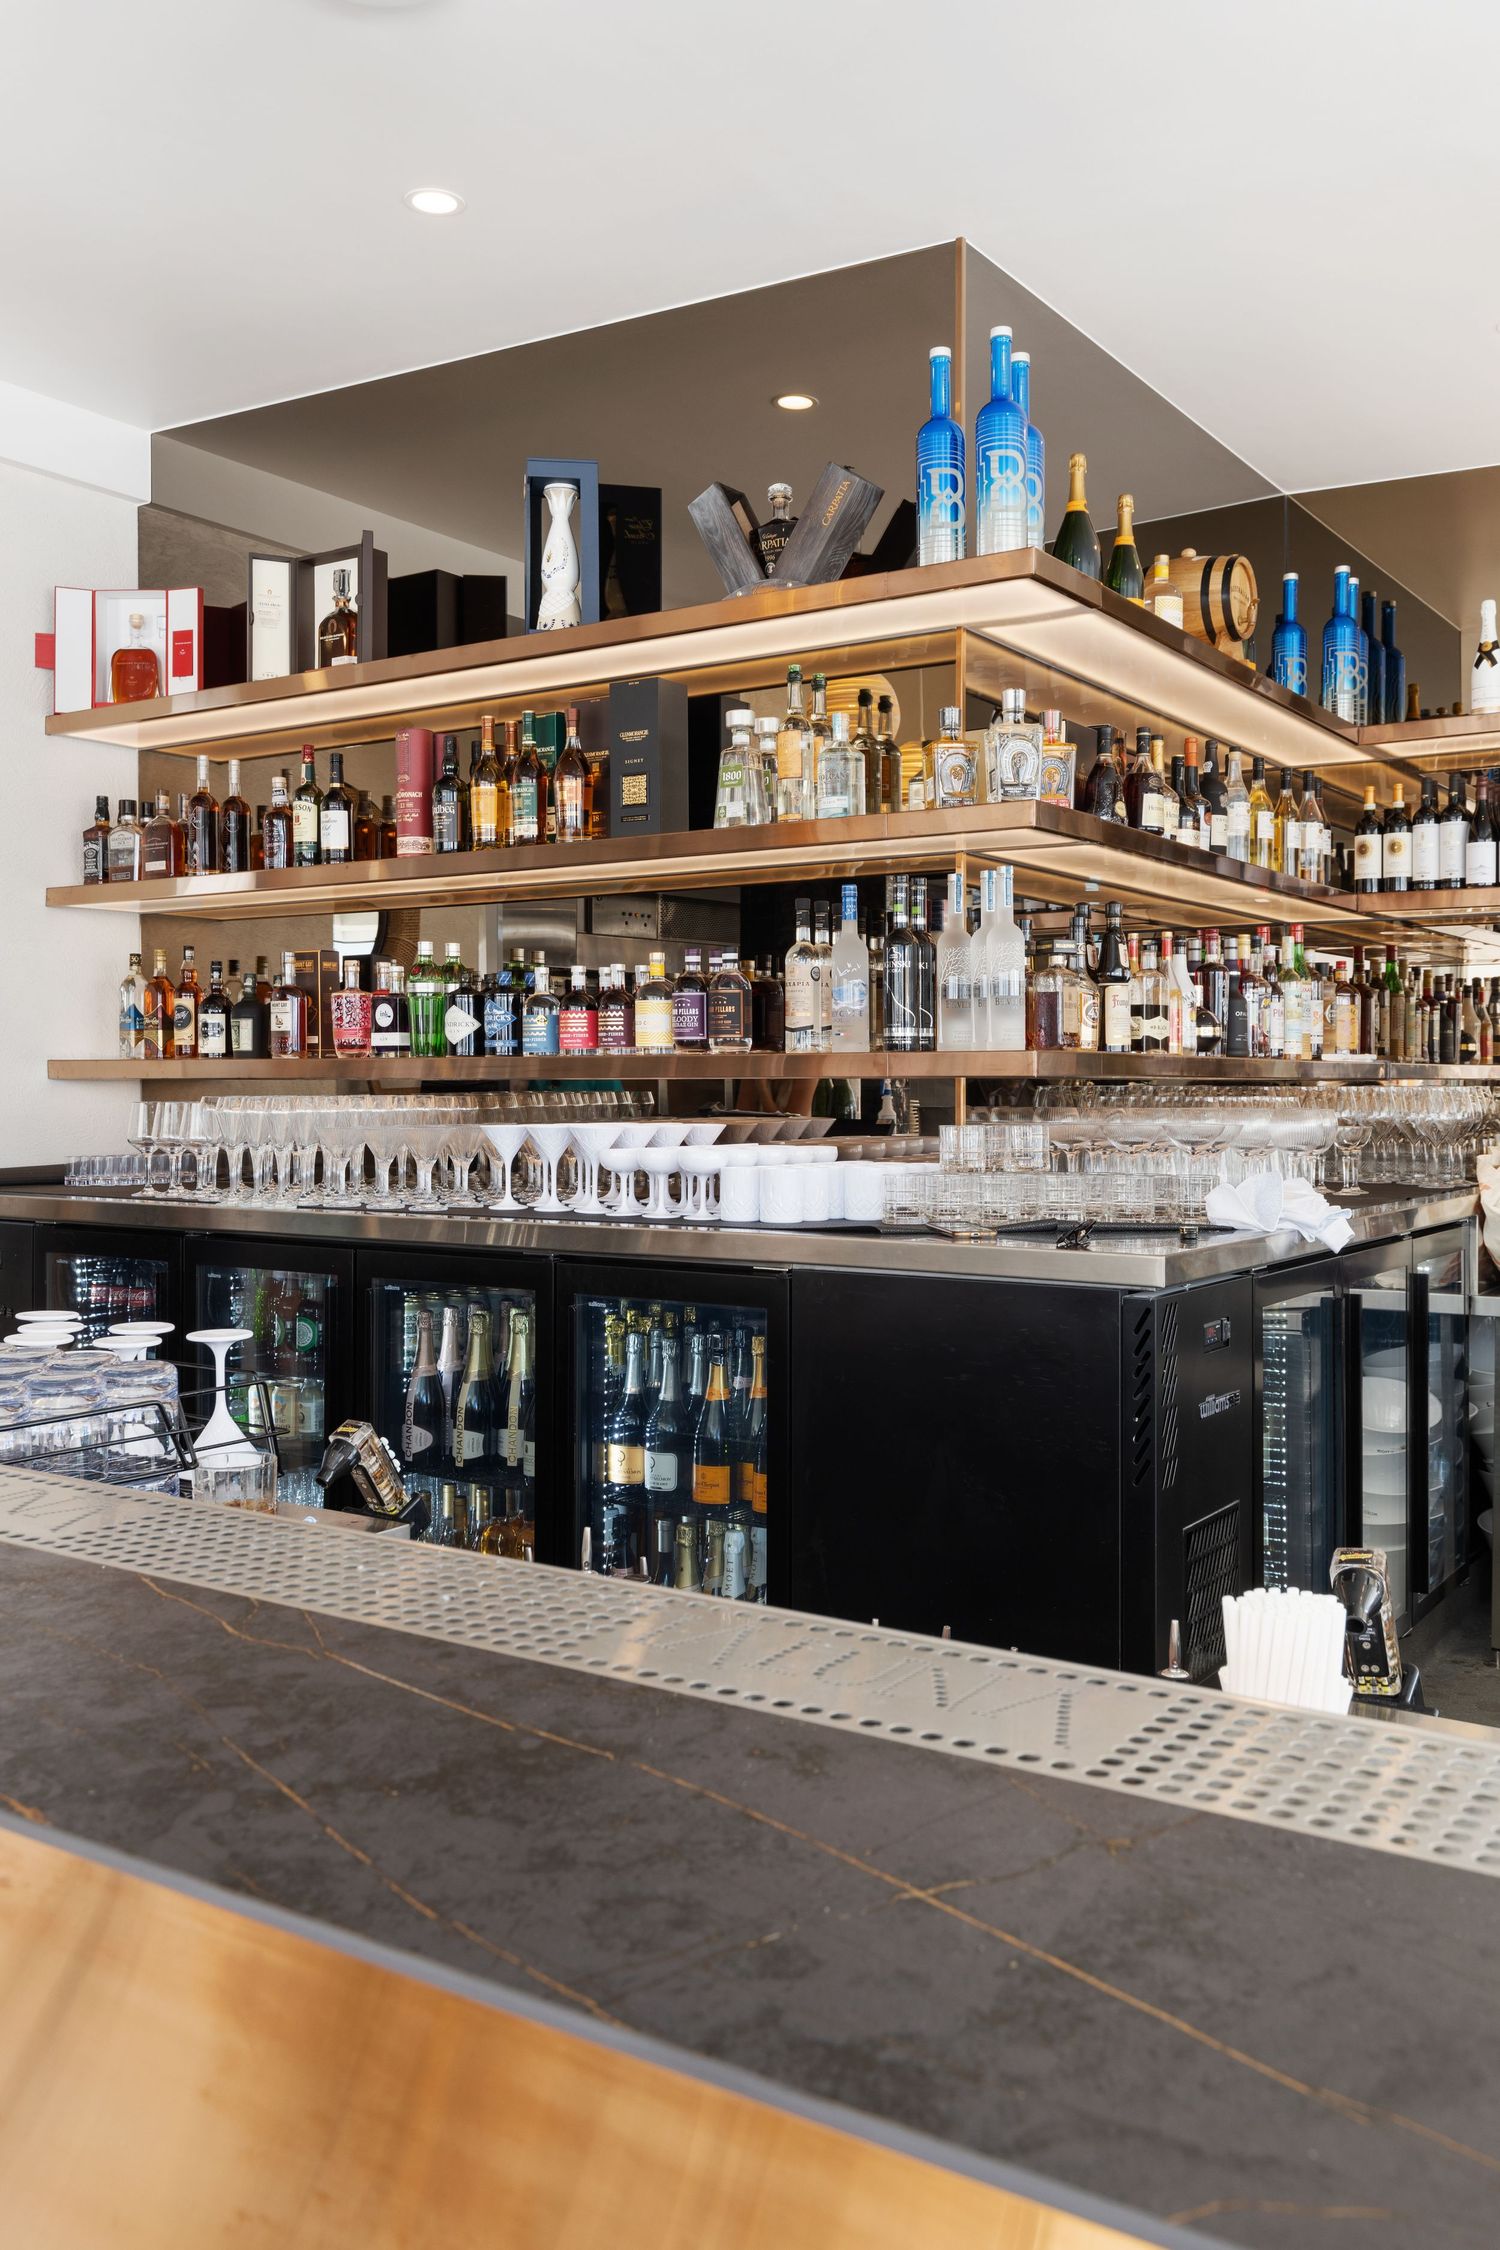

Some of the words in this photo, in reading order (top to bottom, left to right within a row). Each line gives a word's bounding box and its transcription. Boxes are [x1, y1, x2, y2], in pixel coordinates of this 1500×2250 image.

[822, 480, 851, 526] CARPATIA
[722, 770, 742, 781] 1800
[405, 1402, 414, 1458] CHANDON
[1200, 1397, 1230, 1419] williams
[456, 1406, 465, 1464] CHANDON
[508, 1407, 518, 1464] CHANDON
